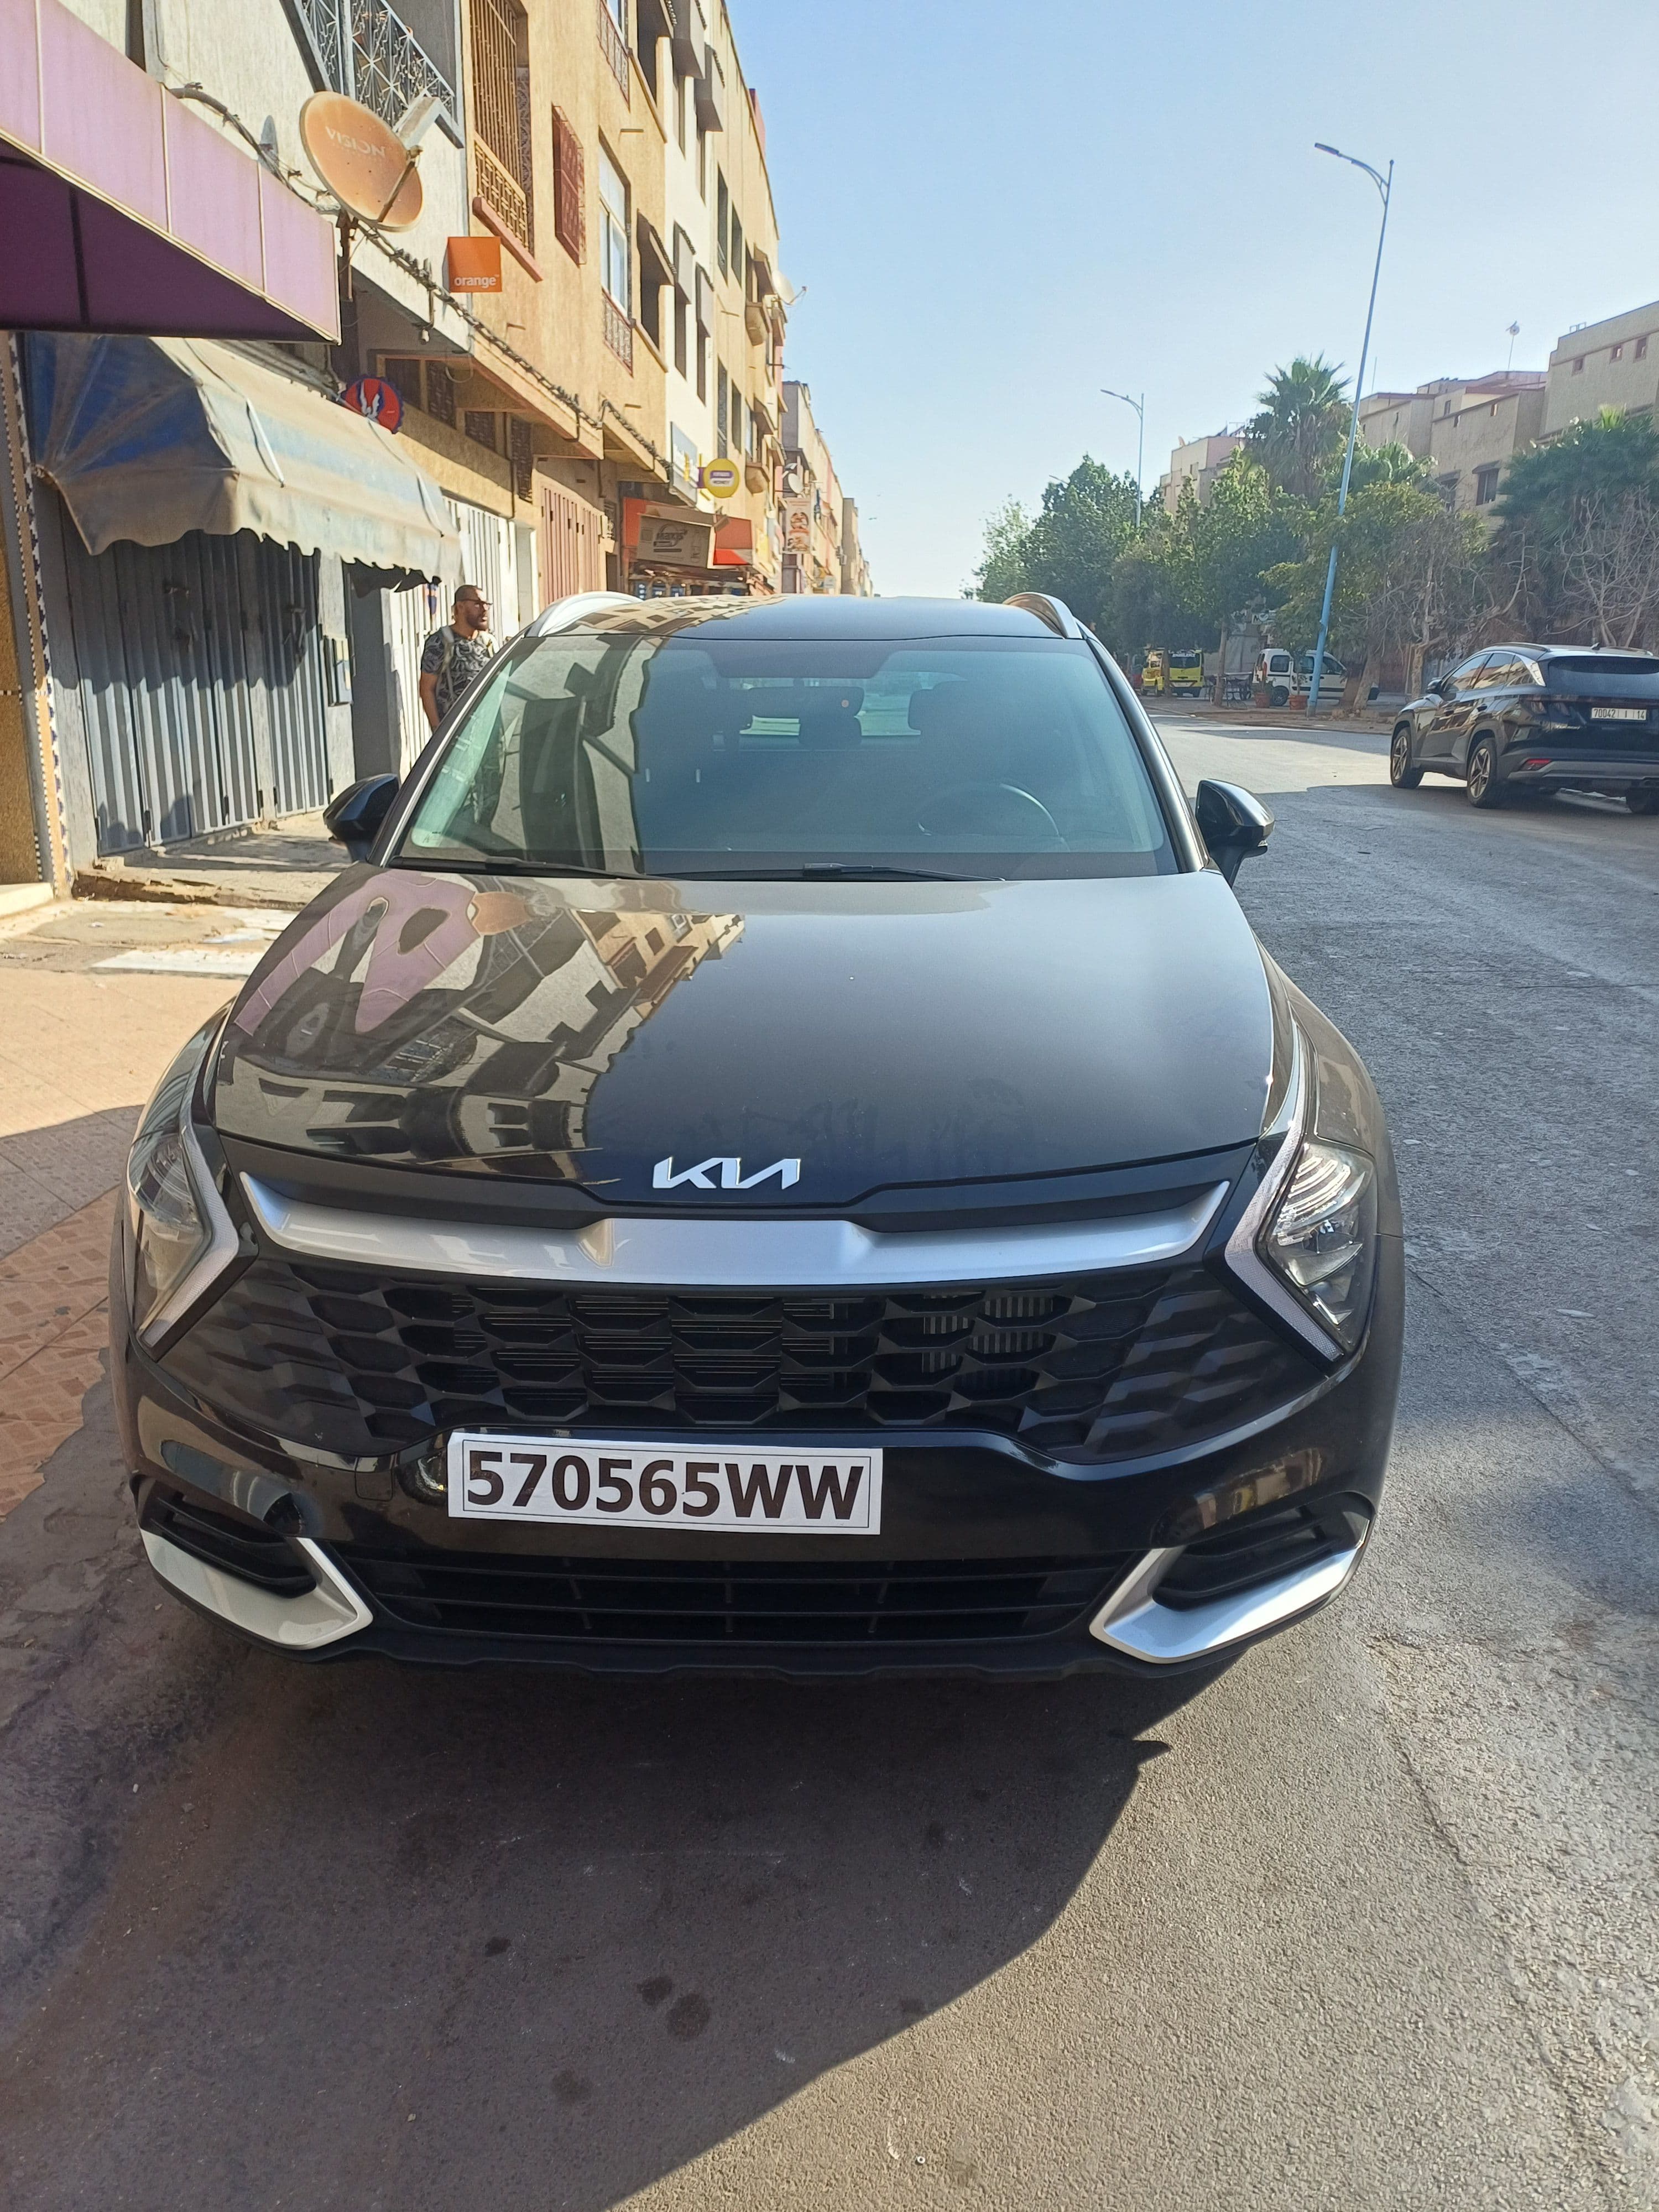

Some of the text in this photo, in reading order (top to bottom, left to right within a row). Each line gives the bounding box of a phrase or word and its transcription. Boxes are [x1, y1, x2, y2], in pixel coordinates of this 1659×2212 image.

[325, 126, 385, 158] VISION
[454, 276, 497, 289] orange
[1594, 708, 1616, 718] 70042
[1637, 710, 1645, 719] 14
[653, 1157, 801, 1190] KIA
[467, 1450, 864, 1520] 570565WW
